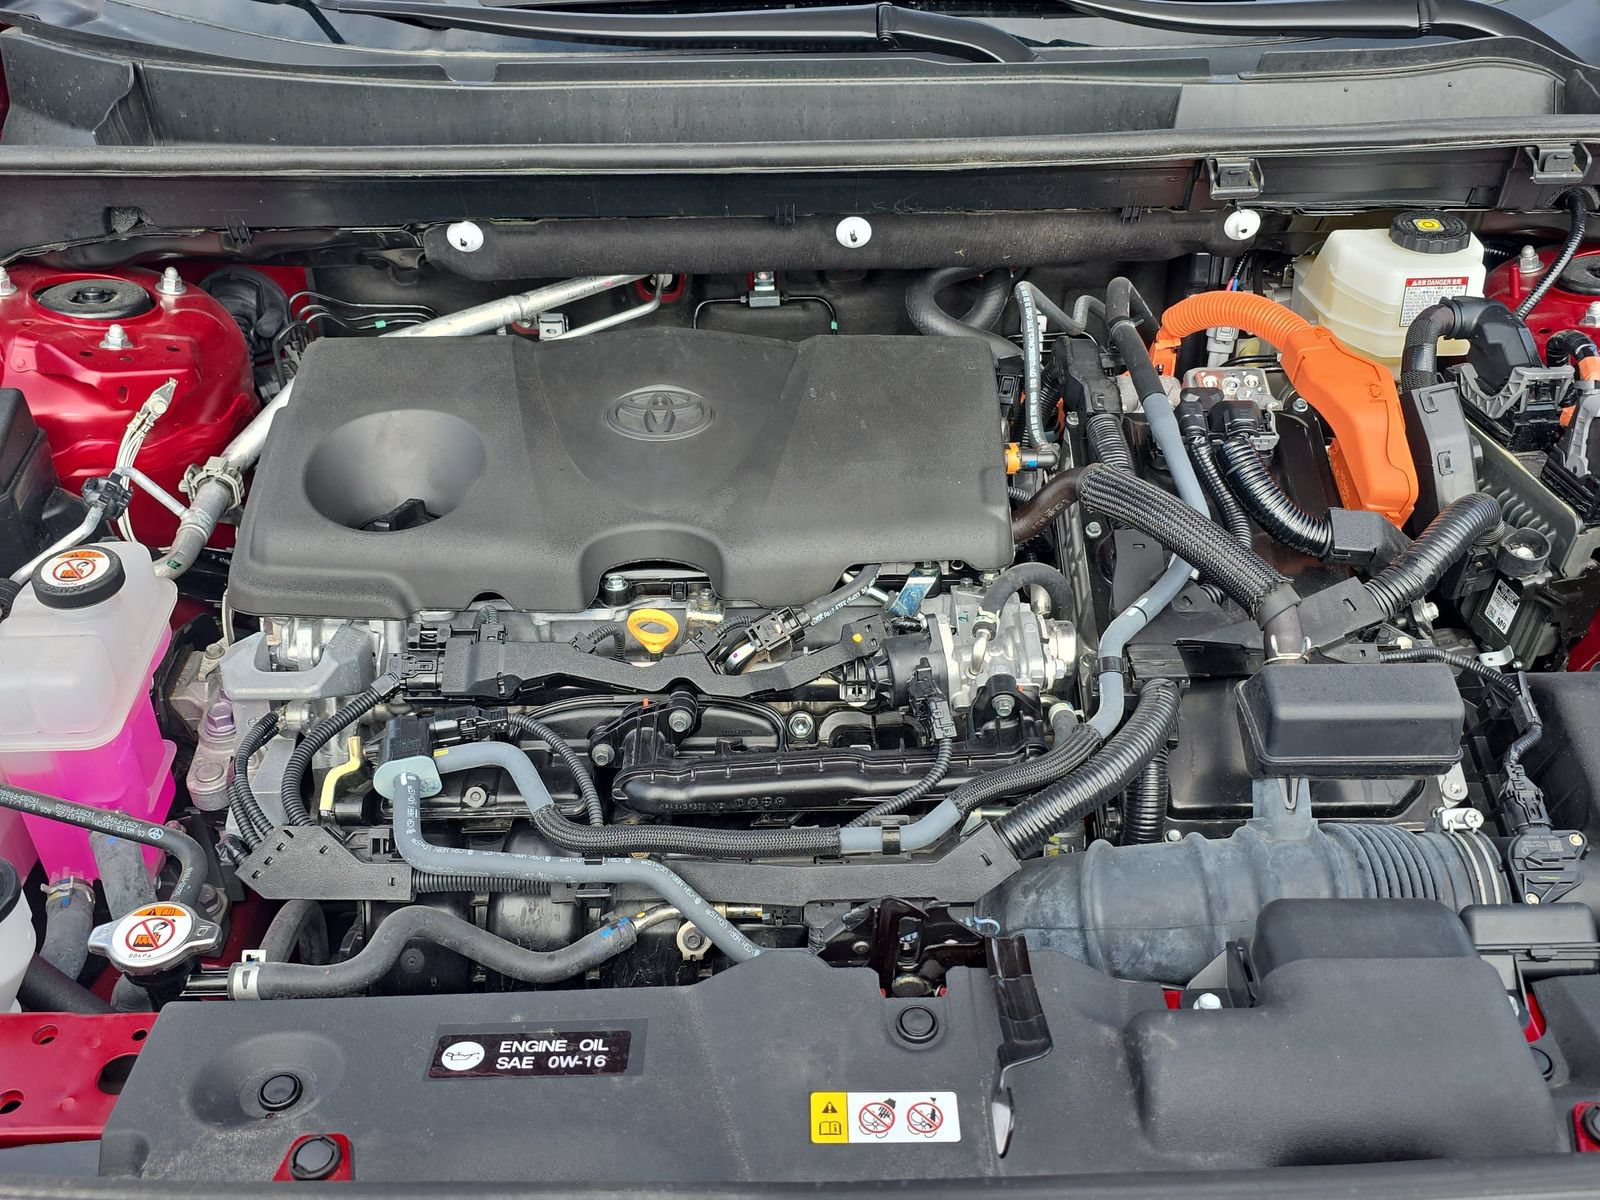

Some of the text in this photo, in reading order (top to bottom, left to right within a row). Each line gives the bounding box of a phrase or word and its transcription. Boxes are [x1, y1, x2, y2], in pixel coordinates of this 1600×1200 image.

[499, 1038, 609, 1053] ENGINE OIL
[496, 1054, 607, 1069] SAE 0W-16
